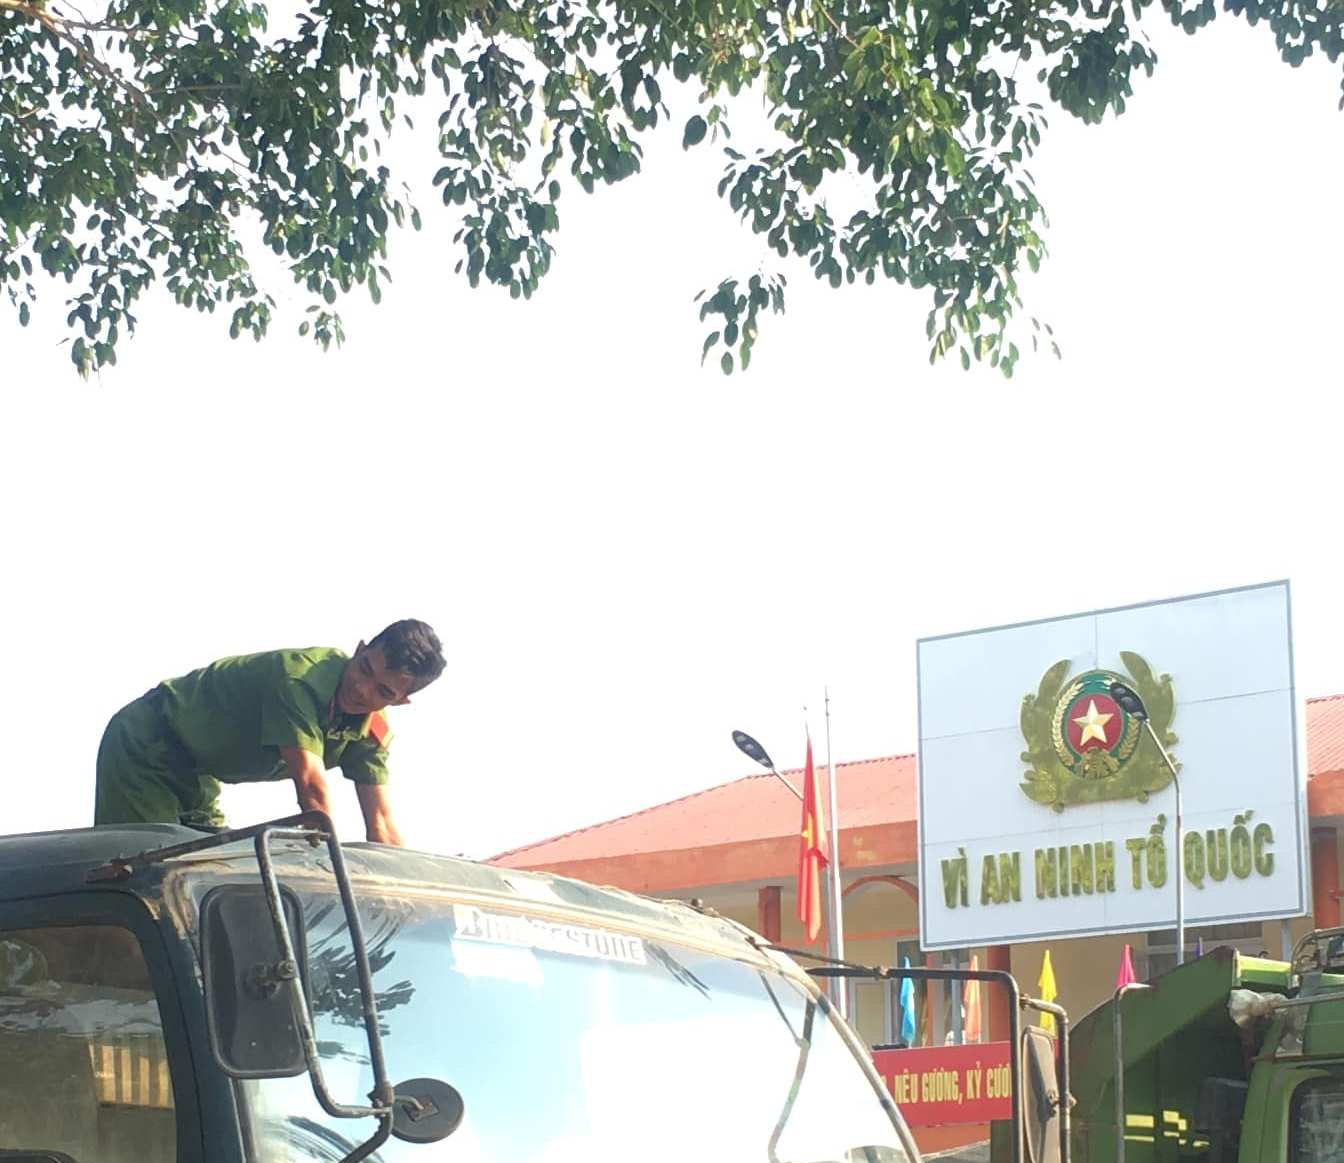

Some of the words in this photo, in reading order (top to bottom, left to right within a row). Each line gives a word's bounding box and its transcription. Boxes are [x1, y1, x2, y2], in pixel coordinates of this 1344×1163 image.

[941, 847, 970, 909] VÌ
[980, 852, 1022, 906] AN
[1034, 841, 1116, 900] NINH
[1126, 813, 1169, 890] TỔ
[1183, 810, 1276, 890] QUỐC
[895, 1068, 918, 1104] NÊU
[922, 1067, 963, 1105] GƯƠNG,
[966, 1061, 982, 1099] KỶ
